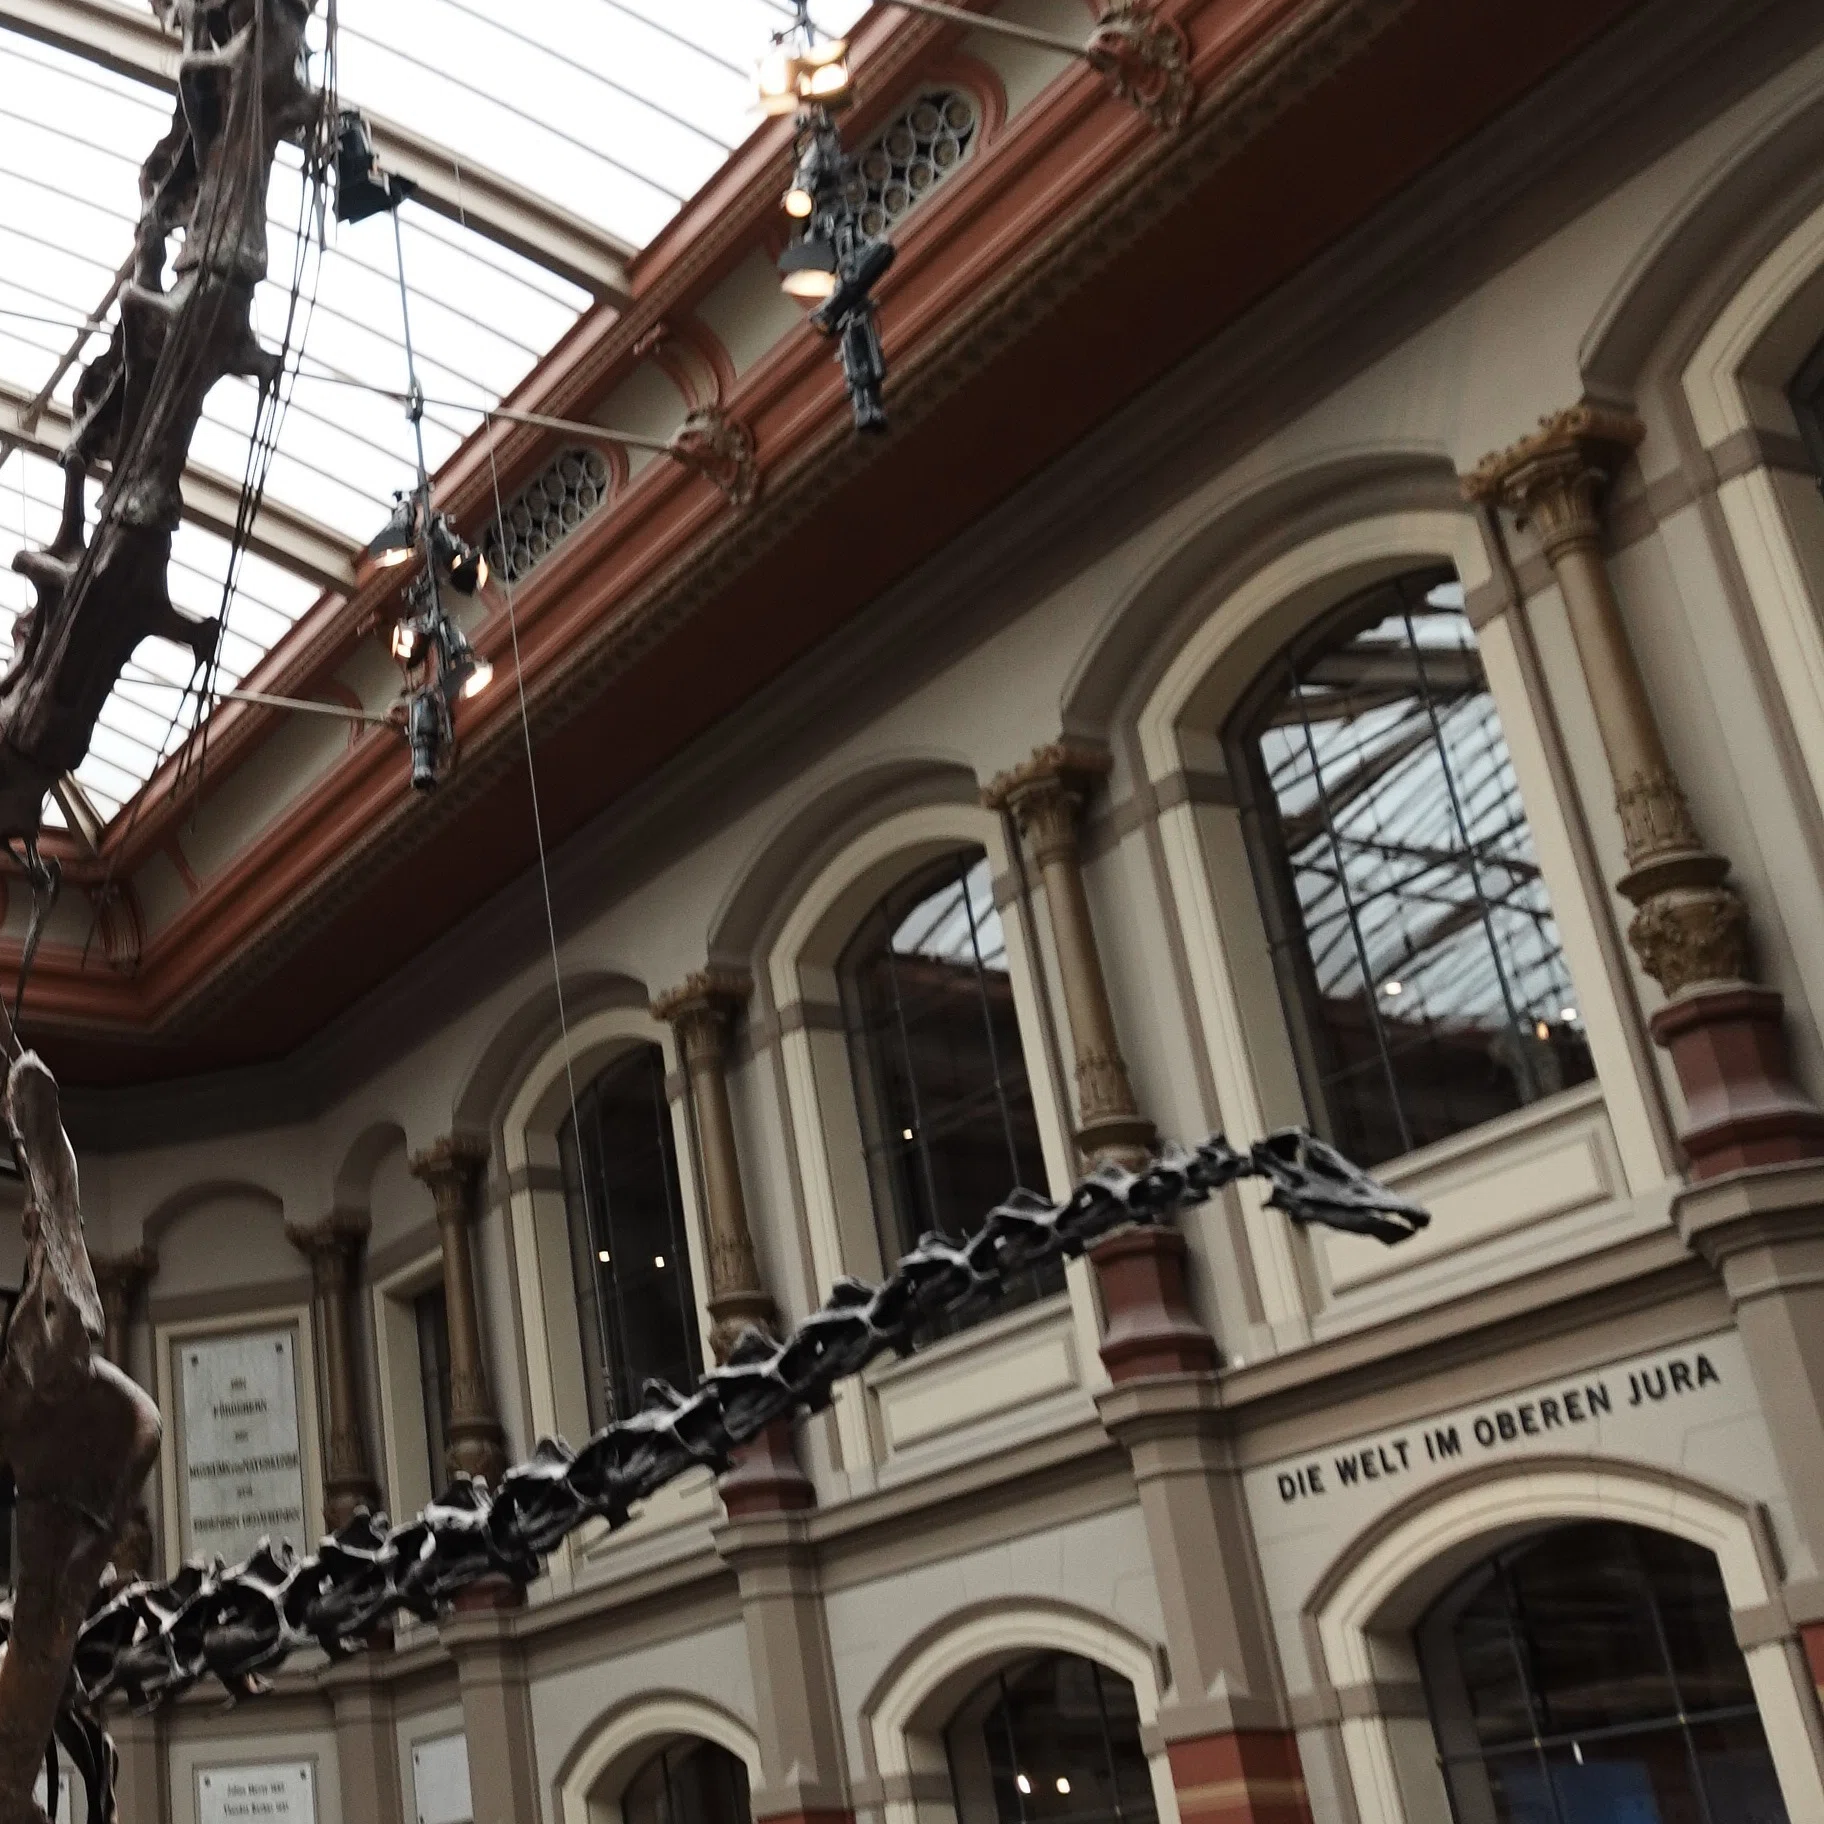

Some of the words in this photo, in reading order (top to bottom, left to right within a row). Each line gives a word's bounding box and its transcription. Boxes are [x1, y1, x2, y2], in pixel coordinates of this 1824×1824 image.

[1278, 1466, 1324, 1503] DIE
[1335, 1440, 1412, 1488] WELT
[1423, 1426, 1464, 1462] IM
[1474, 1383, 1613, 1448] OBEREN
[1627, 1353, 1720, 1408] JURA
